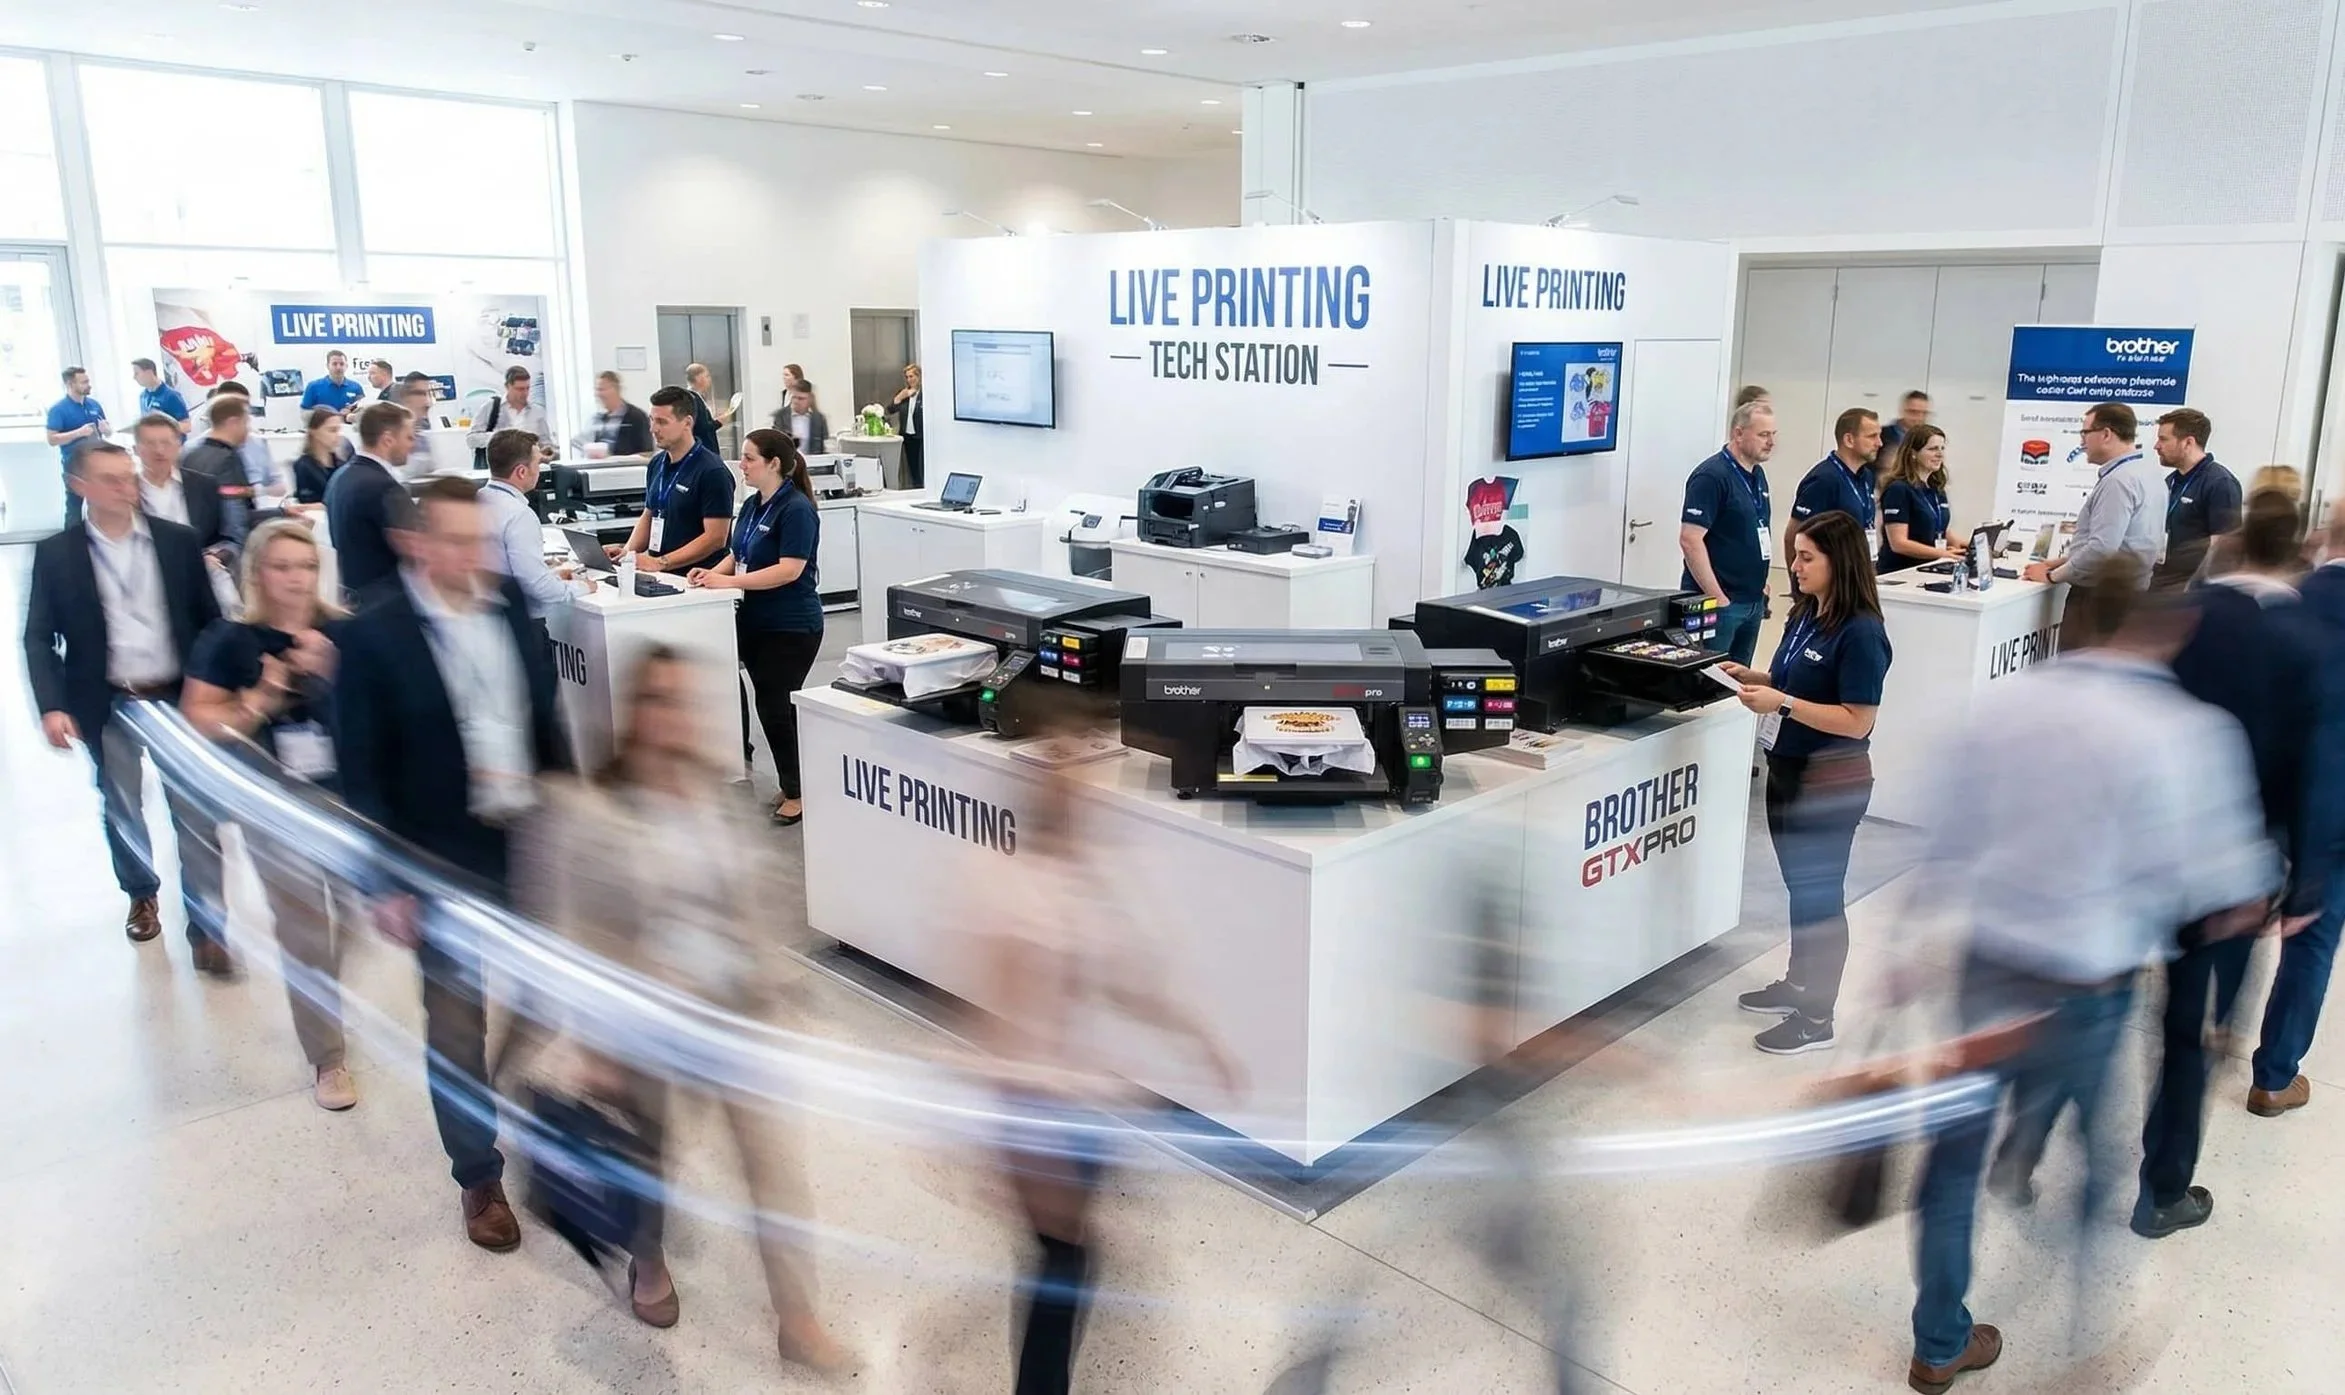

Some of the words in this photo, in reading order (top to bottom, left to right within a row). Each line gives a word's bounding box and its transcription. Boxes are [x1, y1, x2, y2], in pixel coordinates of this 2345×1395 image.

[1110, 269, 1180, 326] LIVE
[1192, 265, 1370, 329] PRINTING
[1482, 264, 1530, 308] LIVE
[1536, 267, 1626, 311] PRINTING
[281, 313, 328, 337] LIVE
[331, 313, 425, 338] PRINTING
[2106, 337, 2179, 355] brother
[1150, 340, 1207, 380] TECH
[1215, 342, 1318, 385] STATION
[550, 640, 587, 687] TING
[1990, 637, 2020, 680] LIVE
[2021, 623, 2060, 669] PRINT
[1164, 684, 1201, 695] brother
[1365, 688, 1383, 698] pro
[843, 754, 892, 812] LIVE
[899, 773, 1016, 856] PRINTING
[1584, 763, 1699, 850] BROTHER
